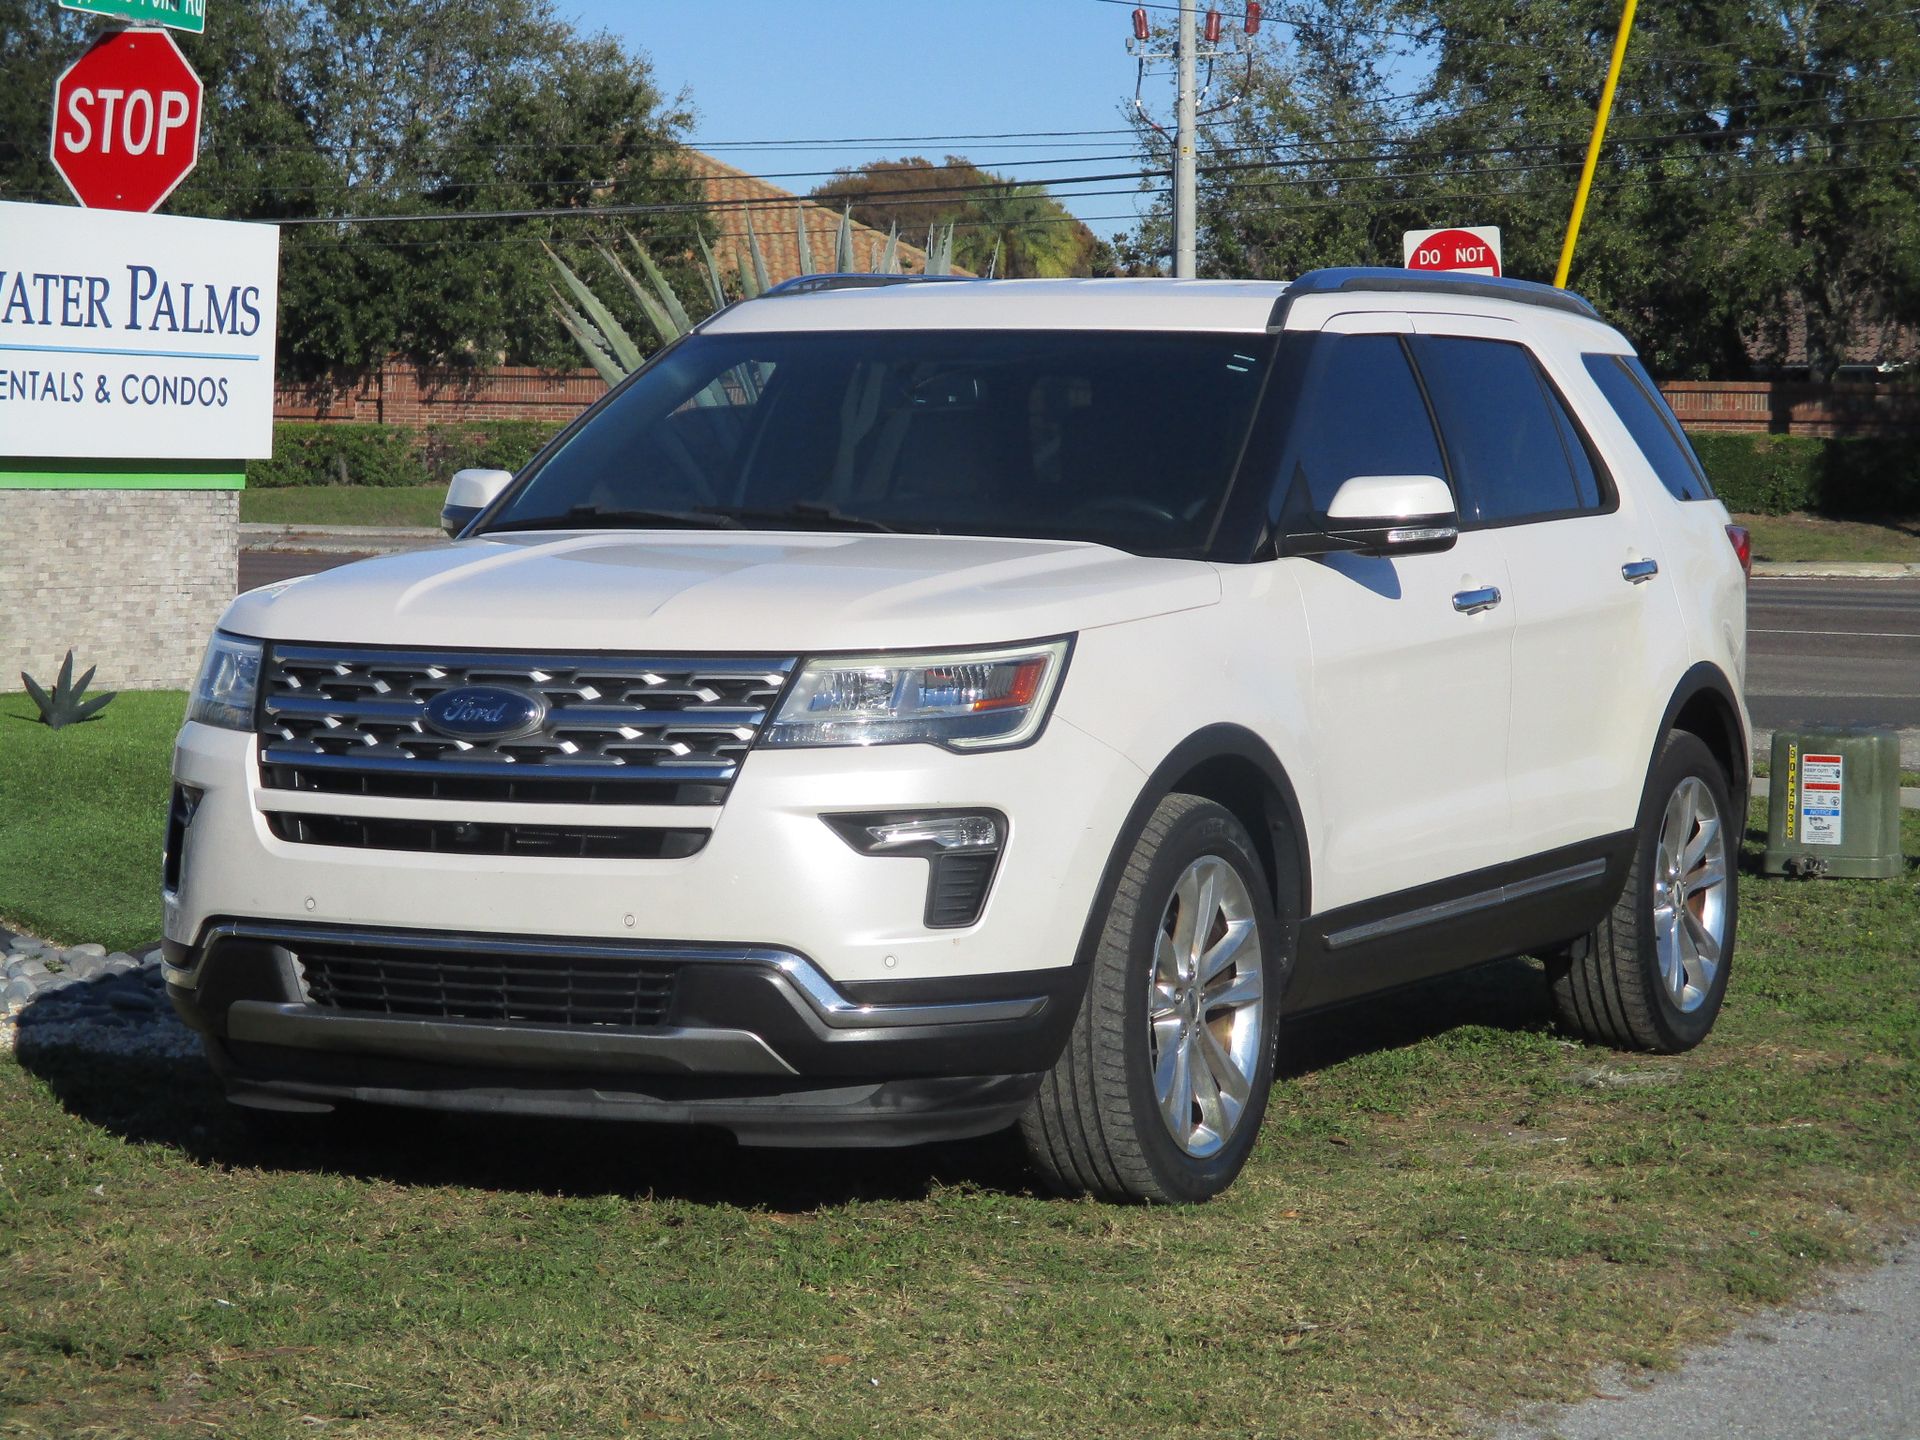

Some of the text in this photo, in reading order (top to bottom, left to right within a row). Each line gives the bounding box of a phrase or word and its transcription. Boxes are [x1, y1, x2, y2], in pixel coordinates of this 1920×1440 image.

[63, 87, 190, 156] STOP
[1419, 246, 1486, 266] DO NOT
[0, 264, 261, 337] ATER PALMS
[95, 374, 111, 403] &
[121, 373, 228, 407] CONDOS
[443, 696, 508, 722] Ford
